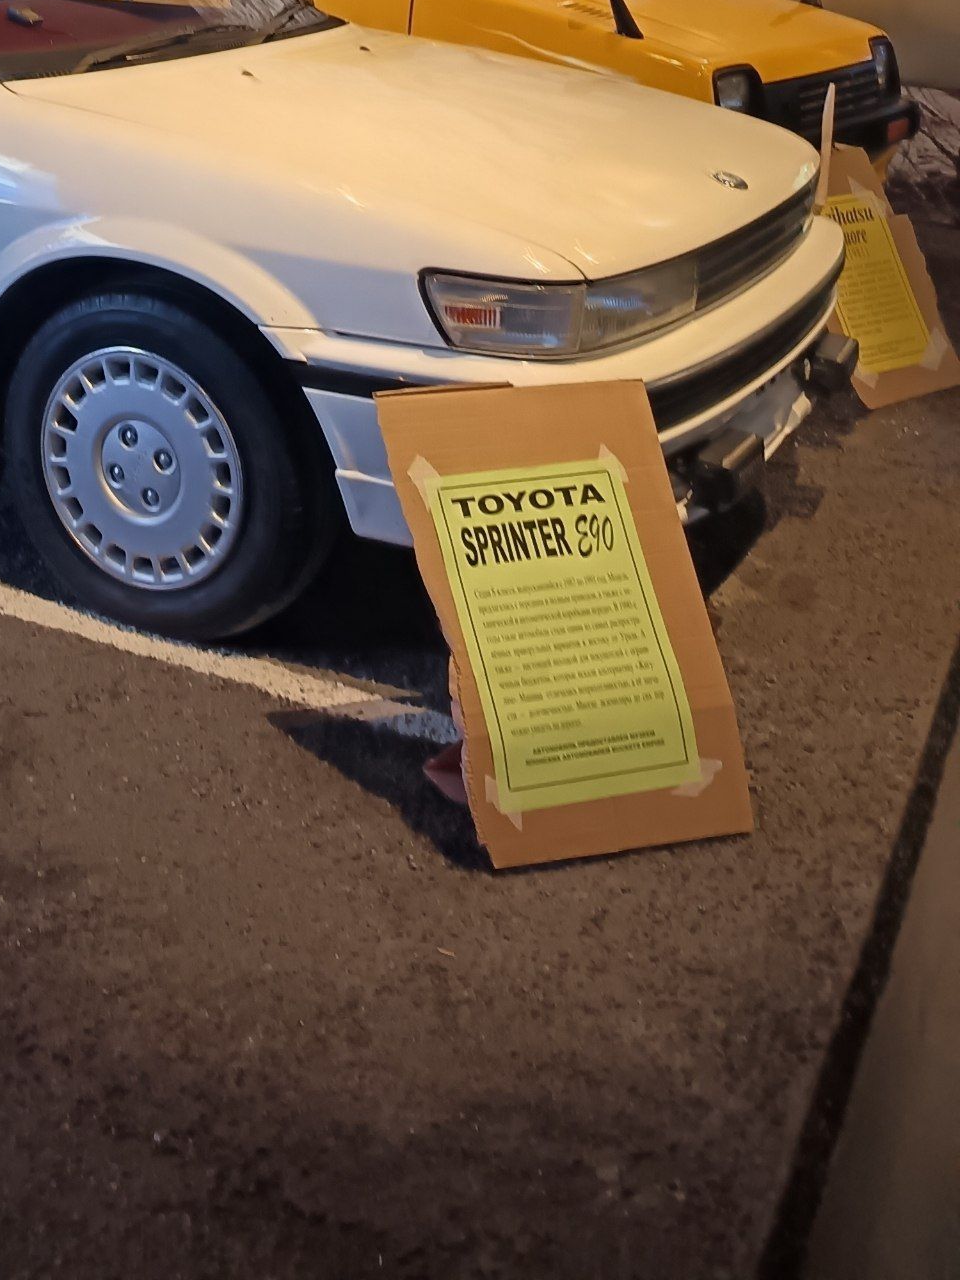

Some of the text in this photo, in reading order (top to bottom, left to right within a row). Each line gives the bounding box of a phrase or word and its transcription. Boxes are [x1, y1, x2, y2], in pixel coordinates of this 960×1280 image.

[826, 206, 874, 226] ihatsu
[843, 229, 868, 247] uore
[451, 483, 606, 519] TOYOTA
[460, 513, 615, 568] SPRINTER E90
